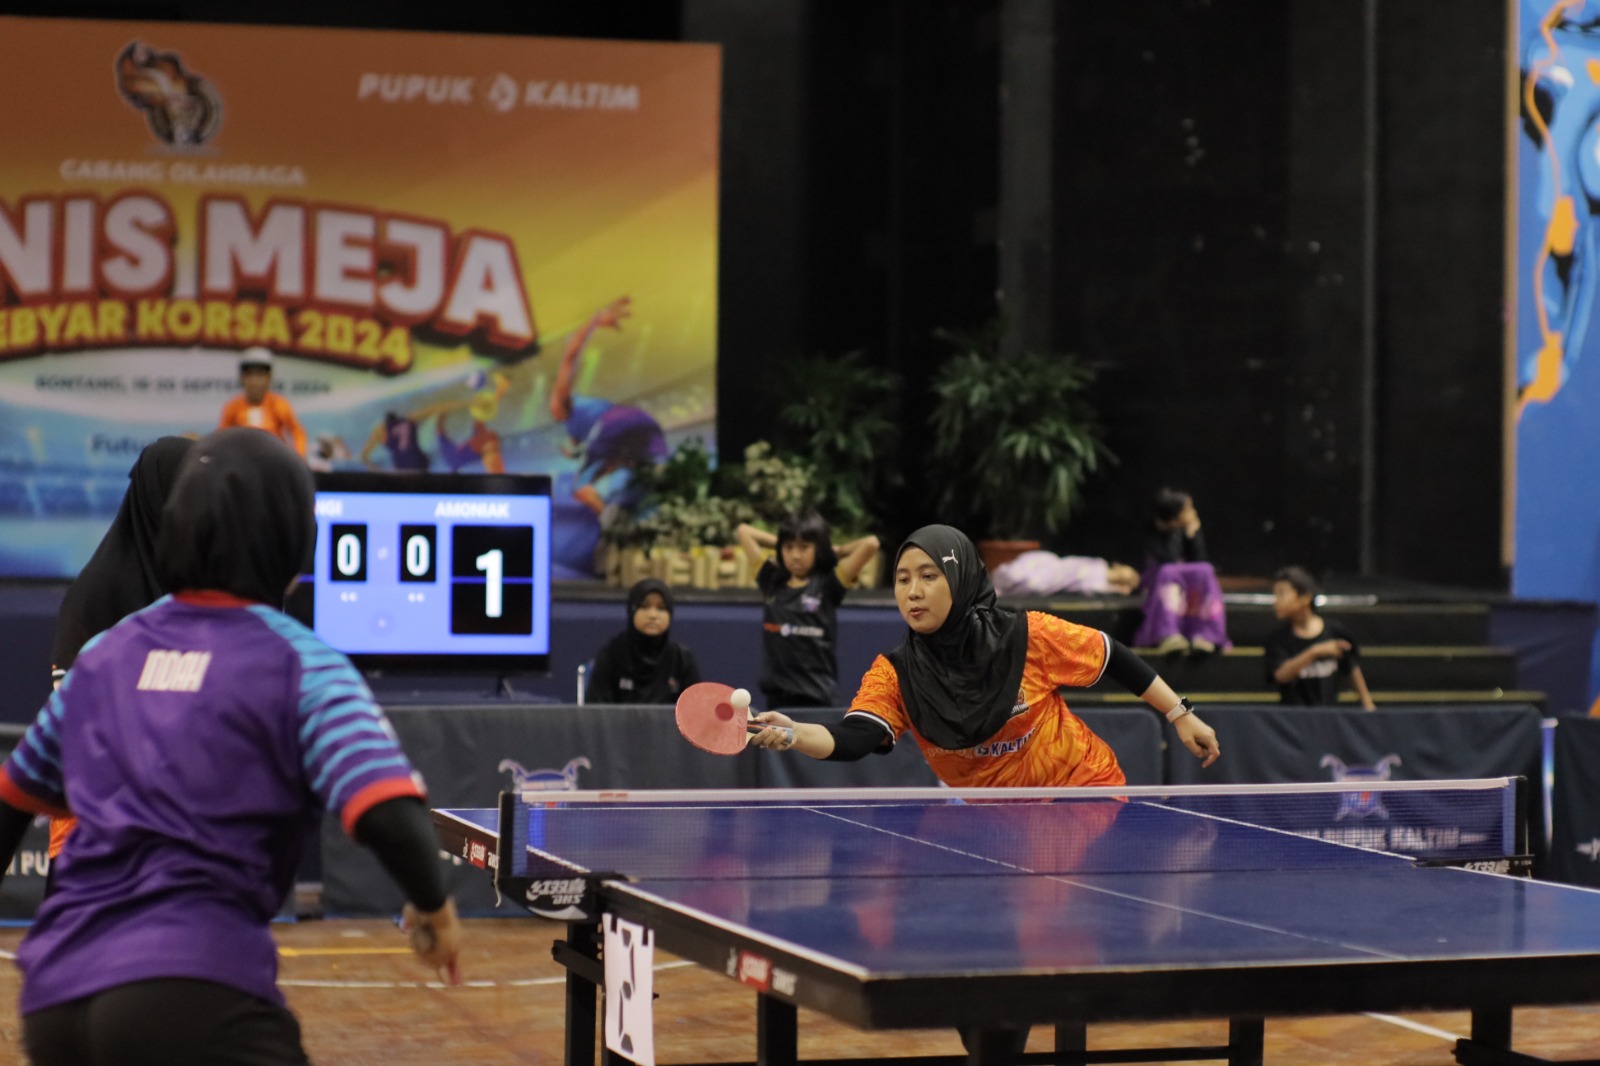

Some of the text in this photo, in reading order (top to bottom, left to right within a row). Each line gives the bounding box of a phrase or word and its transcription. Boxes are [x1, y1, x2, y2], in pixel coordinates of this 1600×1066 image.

[357, 73, 640, 110] PUPUK KALTIM
[60, 159, 163, 181] CABANG
[203, 200, 534, 340] MEJA
[137, 301, 291, 343] KORSA
[298, 311, 411, 375] 2024
[434, 500, 510, 518] AMONIAK
[336, 533, 361, 576] 0
[406, 534, 430, 577] 0
[475, 548, 503, 618] 1
